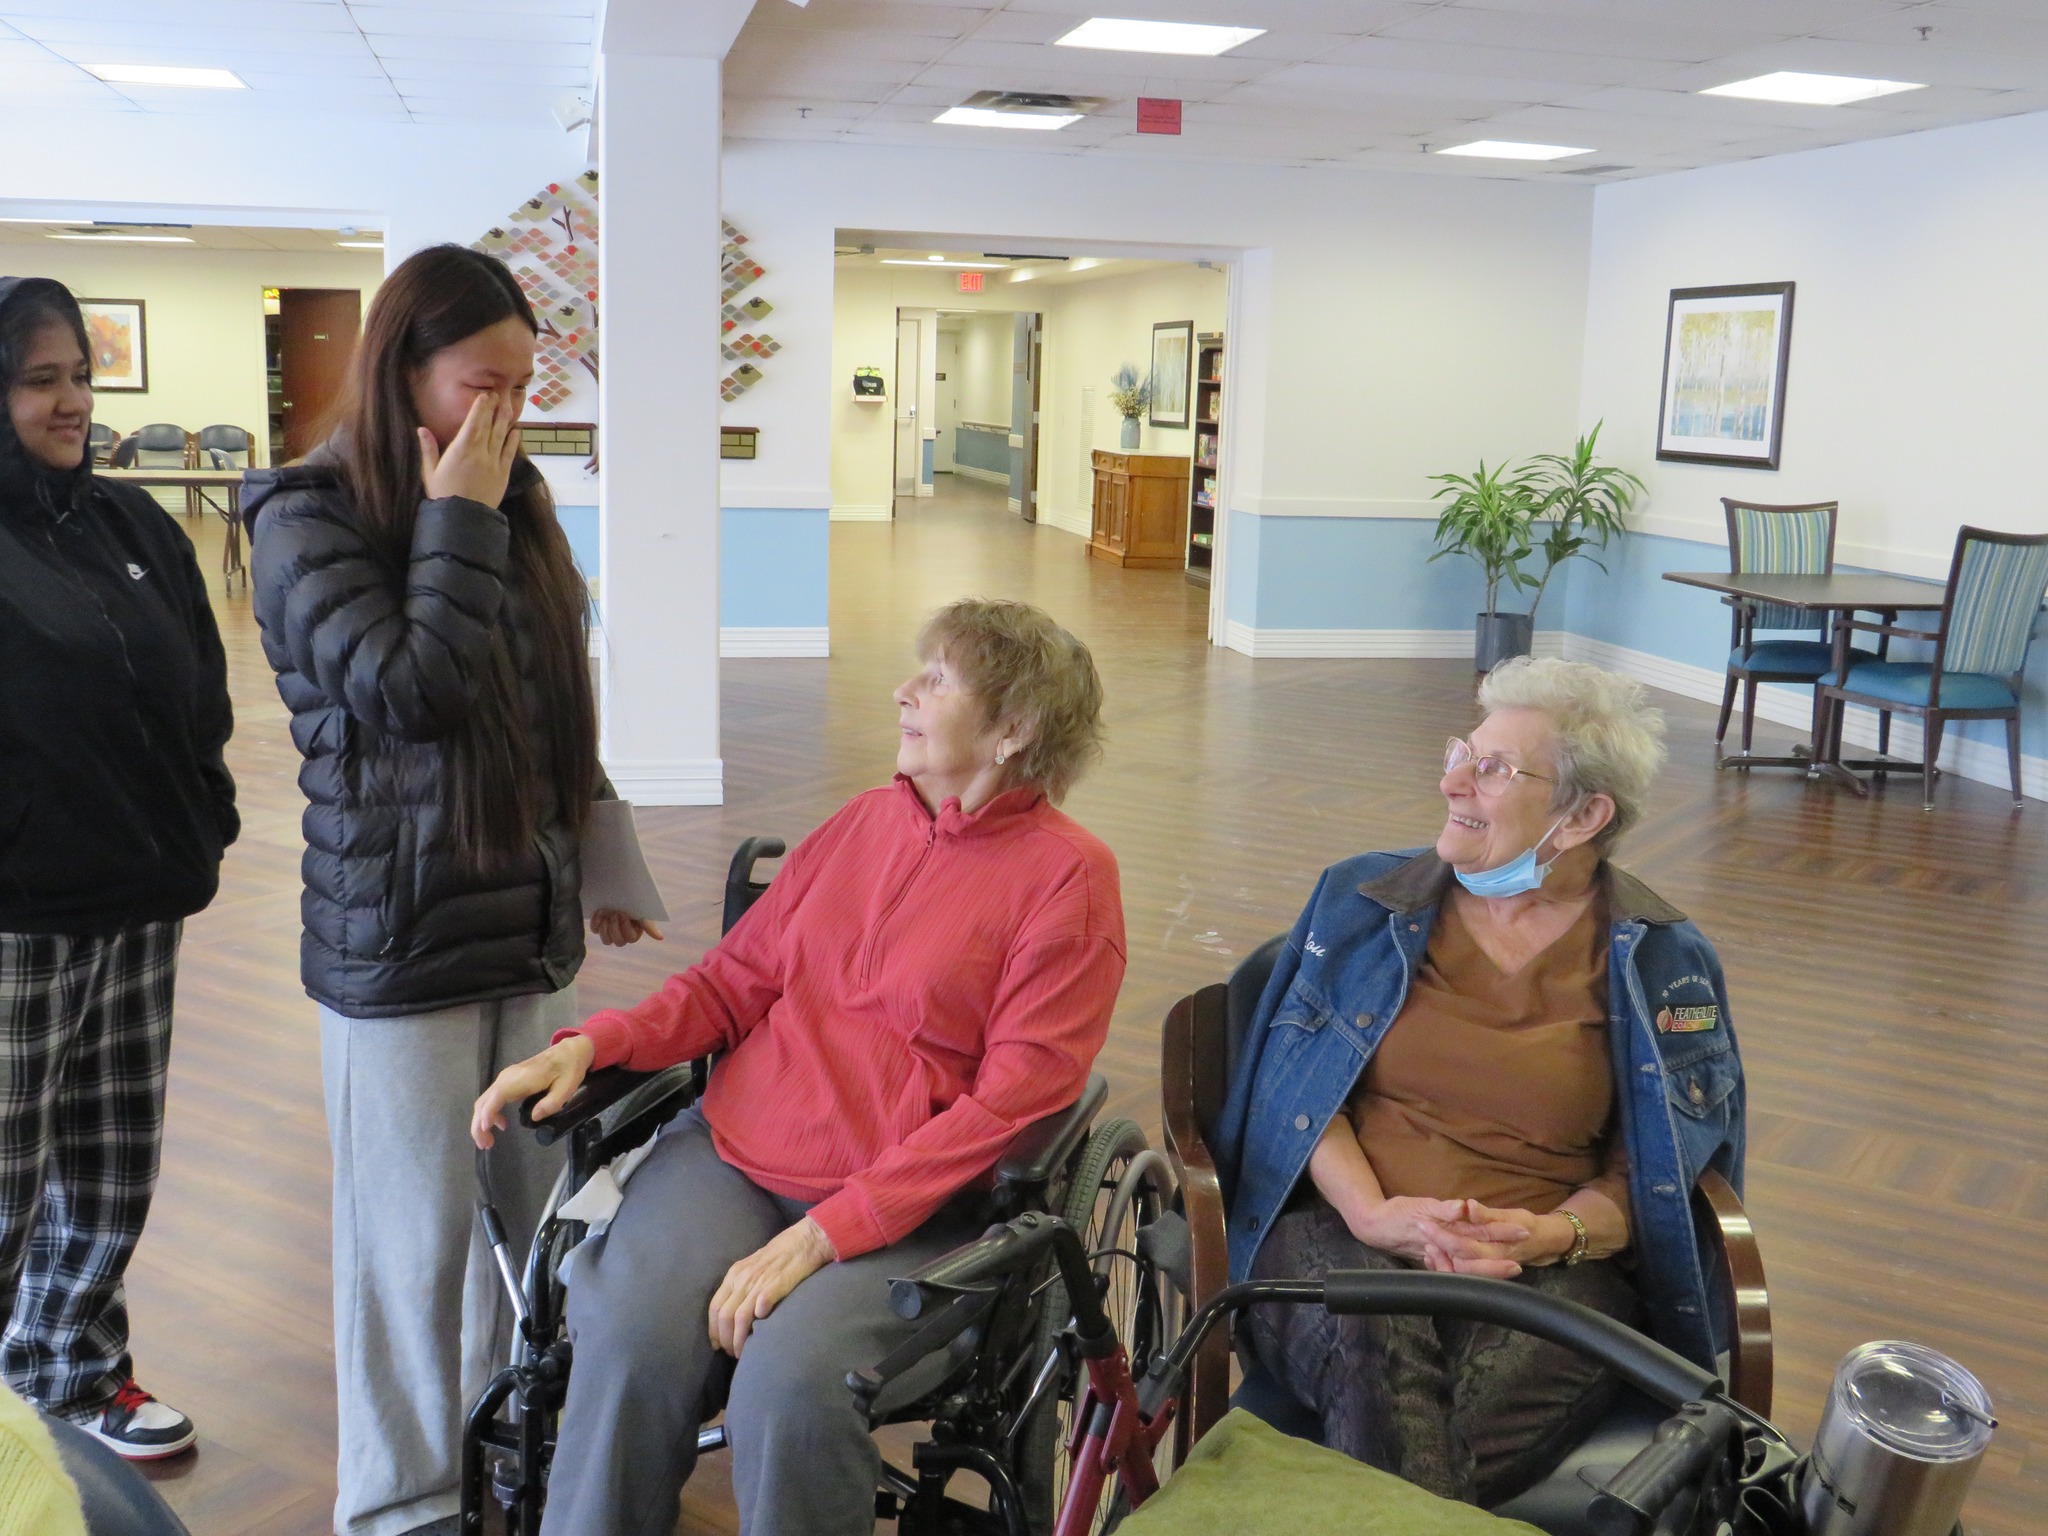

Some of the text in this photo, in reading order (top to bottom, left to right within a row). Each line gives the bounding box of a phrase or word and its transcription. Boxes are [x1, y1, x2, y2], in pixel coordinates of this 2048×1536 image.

[960, 272, 983, 291] EXIT
[1668, 976, 1690, 990] YEARS
[1691, 975, 1698, 983] OF
[1674, 1005, 1718, 1020] FEATHERLITE
